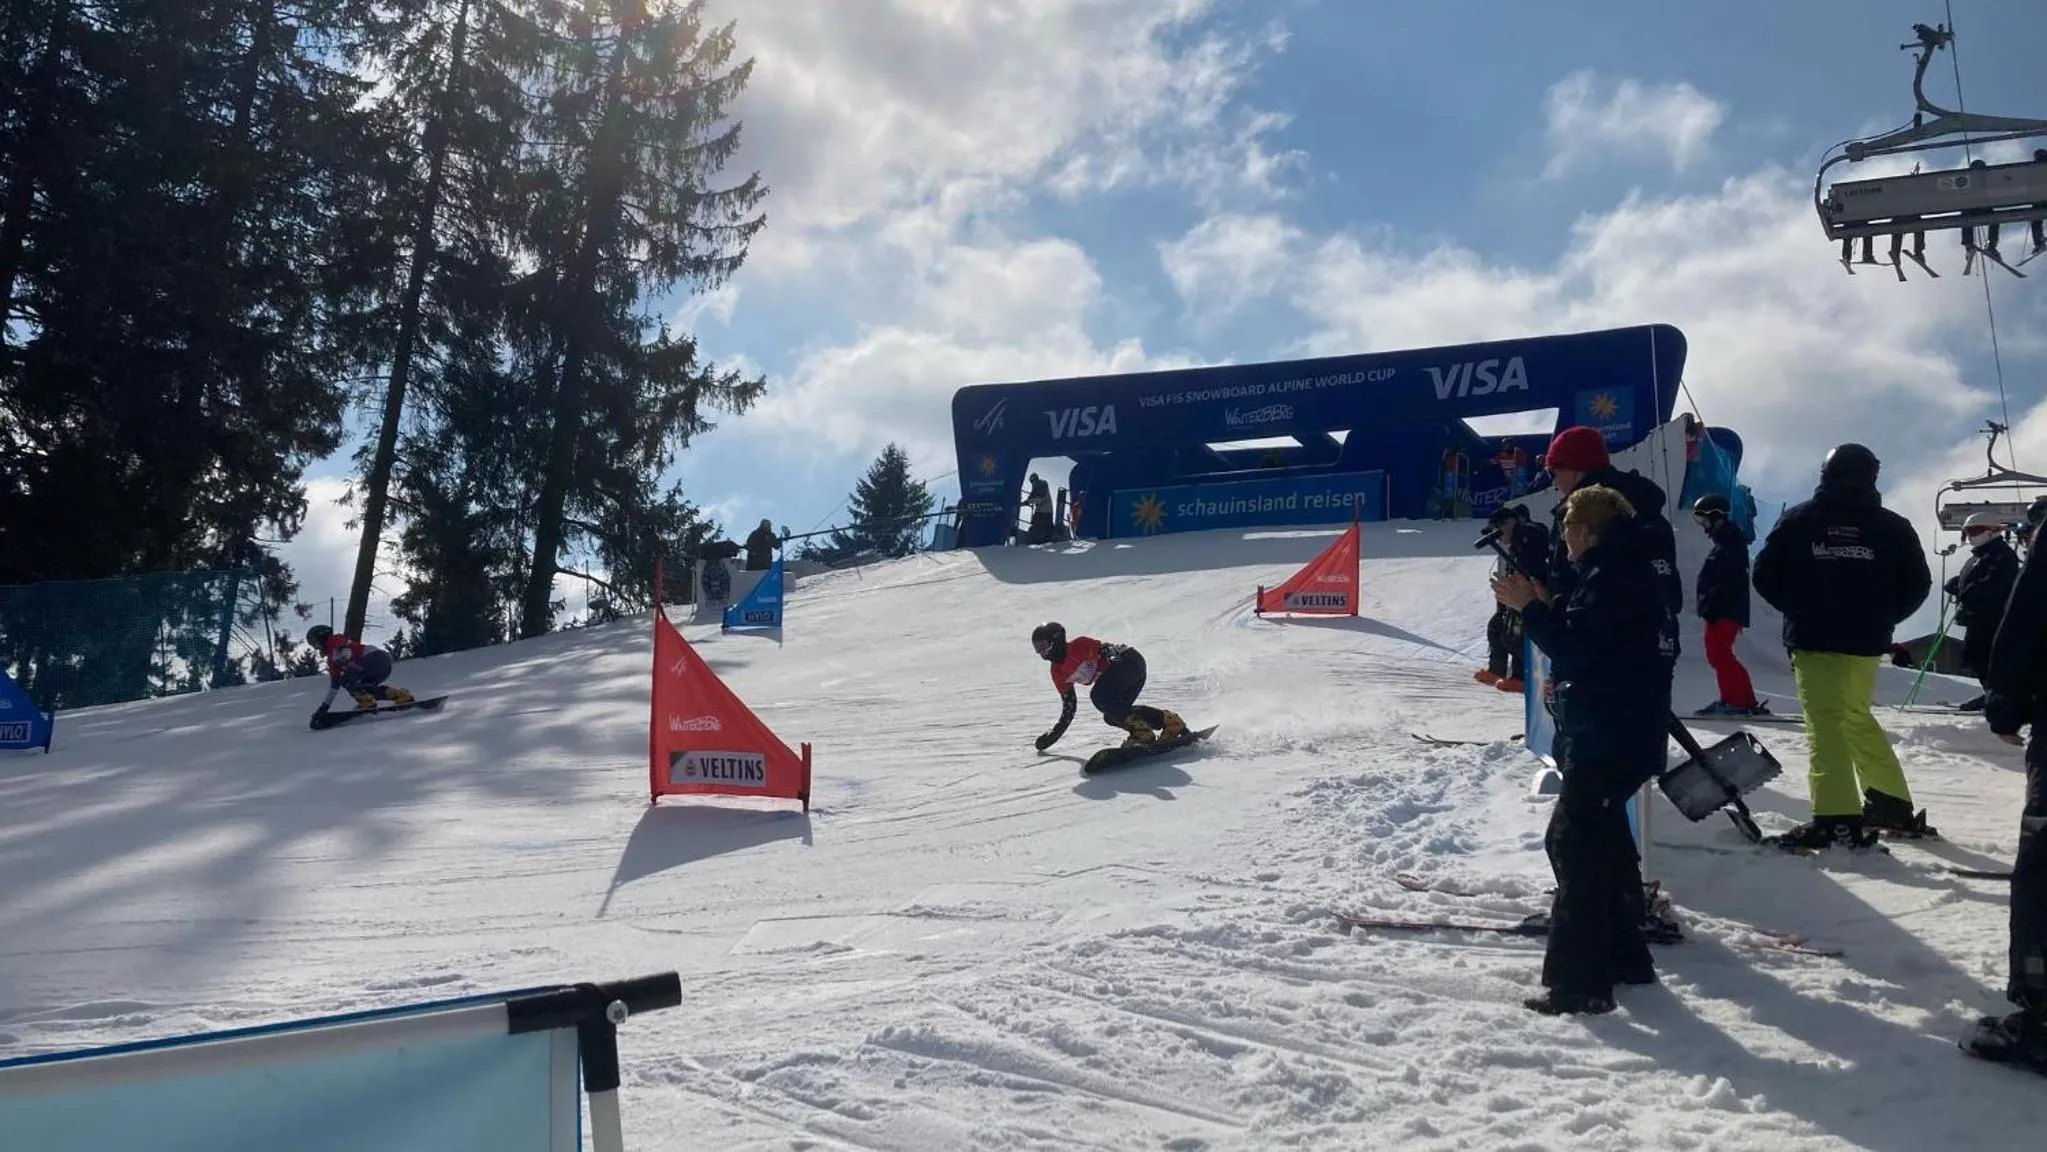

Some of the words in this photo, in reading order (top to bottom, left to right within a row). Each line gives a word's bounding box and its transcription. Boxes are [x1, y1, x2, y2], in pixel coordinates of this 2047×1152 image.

[1139, 395, 1165, 408] VISA
[1165, 392, 1183, 405] FIS
[1185, 384, 1265, 403] SNOWBOARD
[1266, 378, 1312, 393] ALPINE
[1314, 371, 1366, 388] WORLD
[1367, 367, 1396, 382] CUP
[1423, 355, 1529, 399] VISA
[1043, 404, 1118, 439] VISA
[1177, 491, 1298, 517] schauinsland
[1303, 489, 1366, 509] reisen
[1300, 595, 1345, 606] VELTINS
[699, 757, 764, 780] VELTINS
